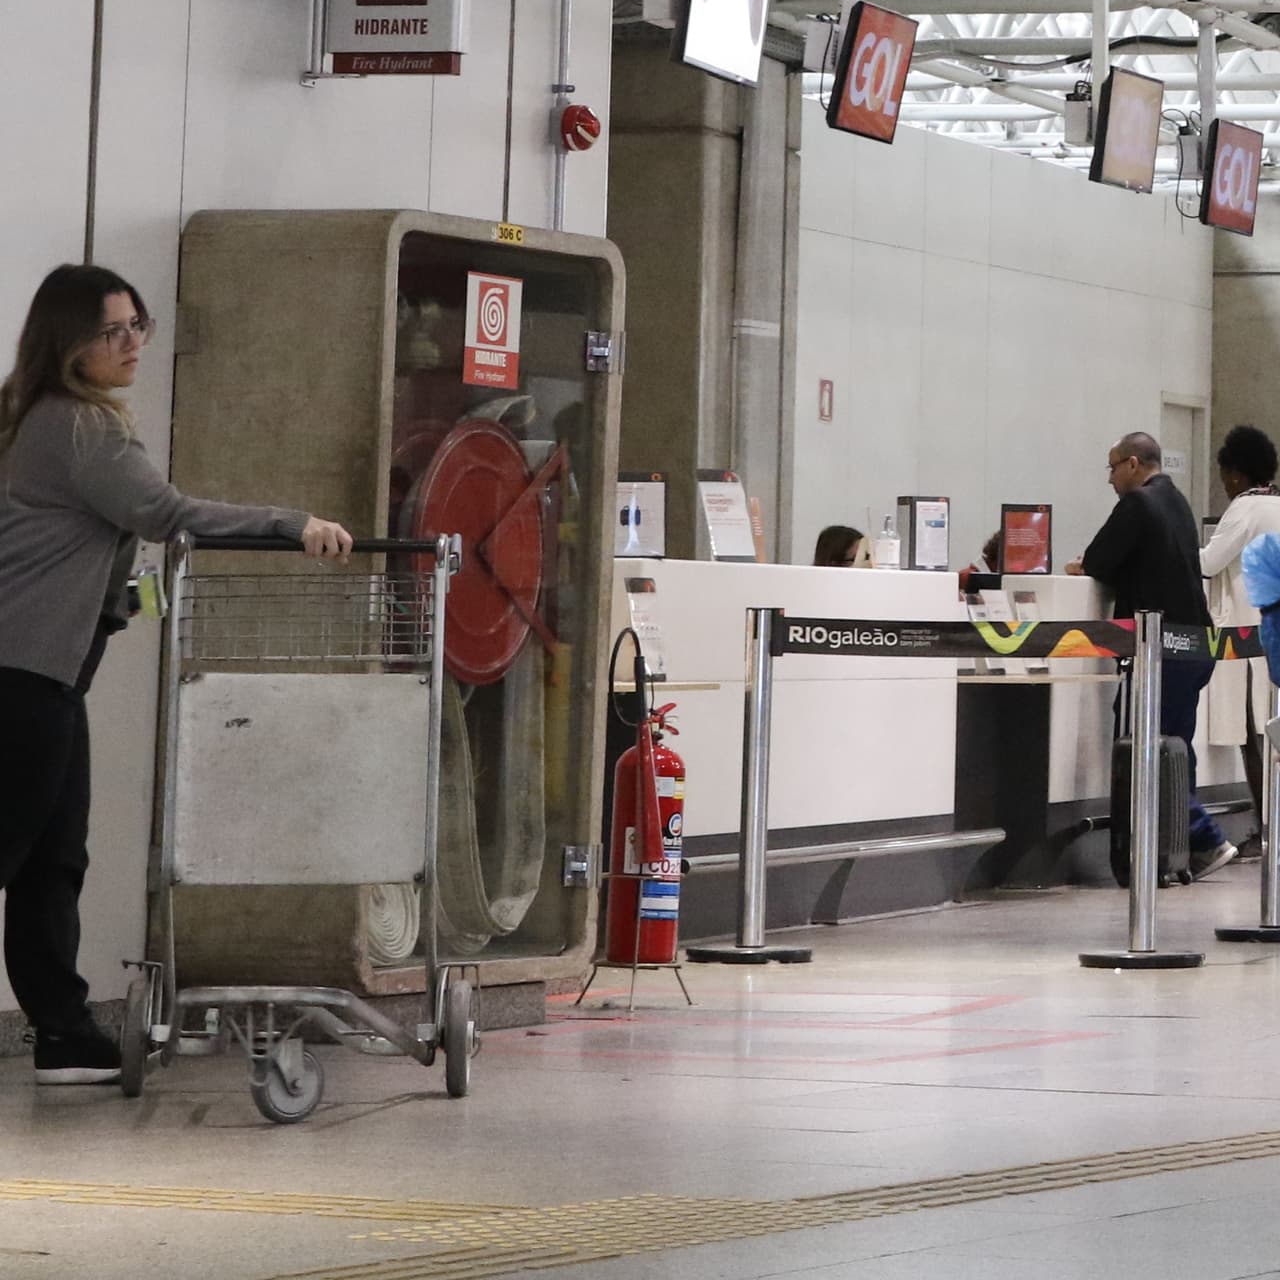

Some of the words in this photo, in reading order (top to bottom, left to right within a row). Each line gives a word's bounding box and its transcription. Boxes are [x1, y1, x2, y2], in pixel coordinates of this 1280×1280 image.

[354, 18, 428, 35] HIDRANTE
[352, 56, 376, 70] Fire
[379, 56, 433, 72] Hydrant
[850, 31, 903, 117] GOL
[1214, 143, 1256, 214] GOL
[498, 226, 514, 241] 306
[516, 229, 522, 241] C
